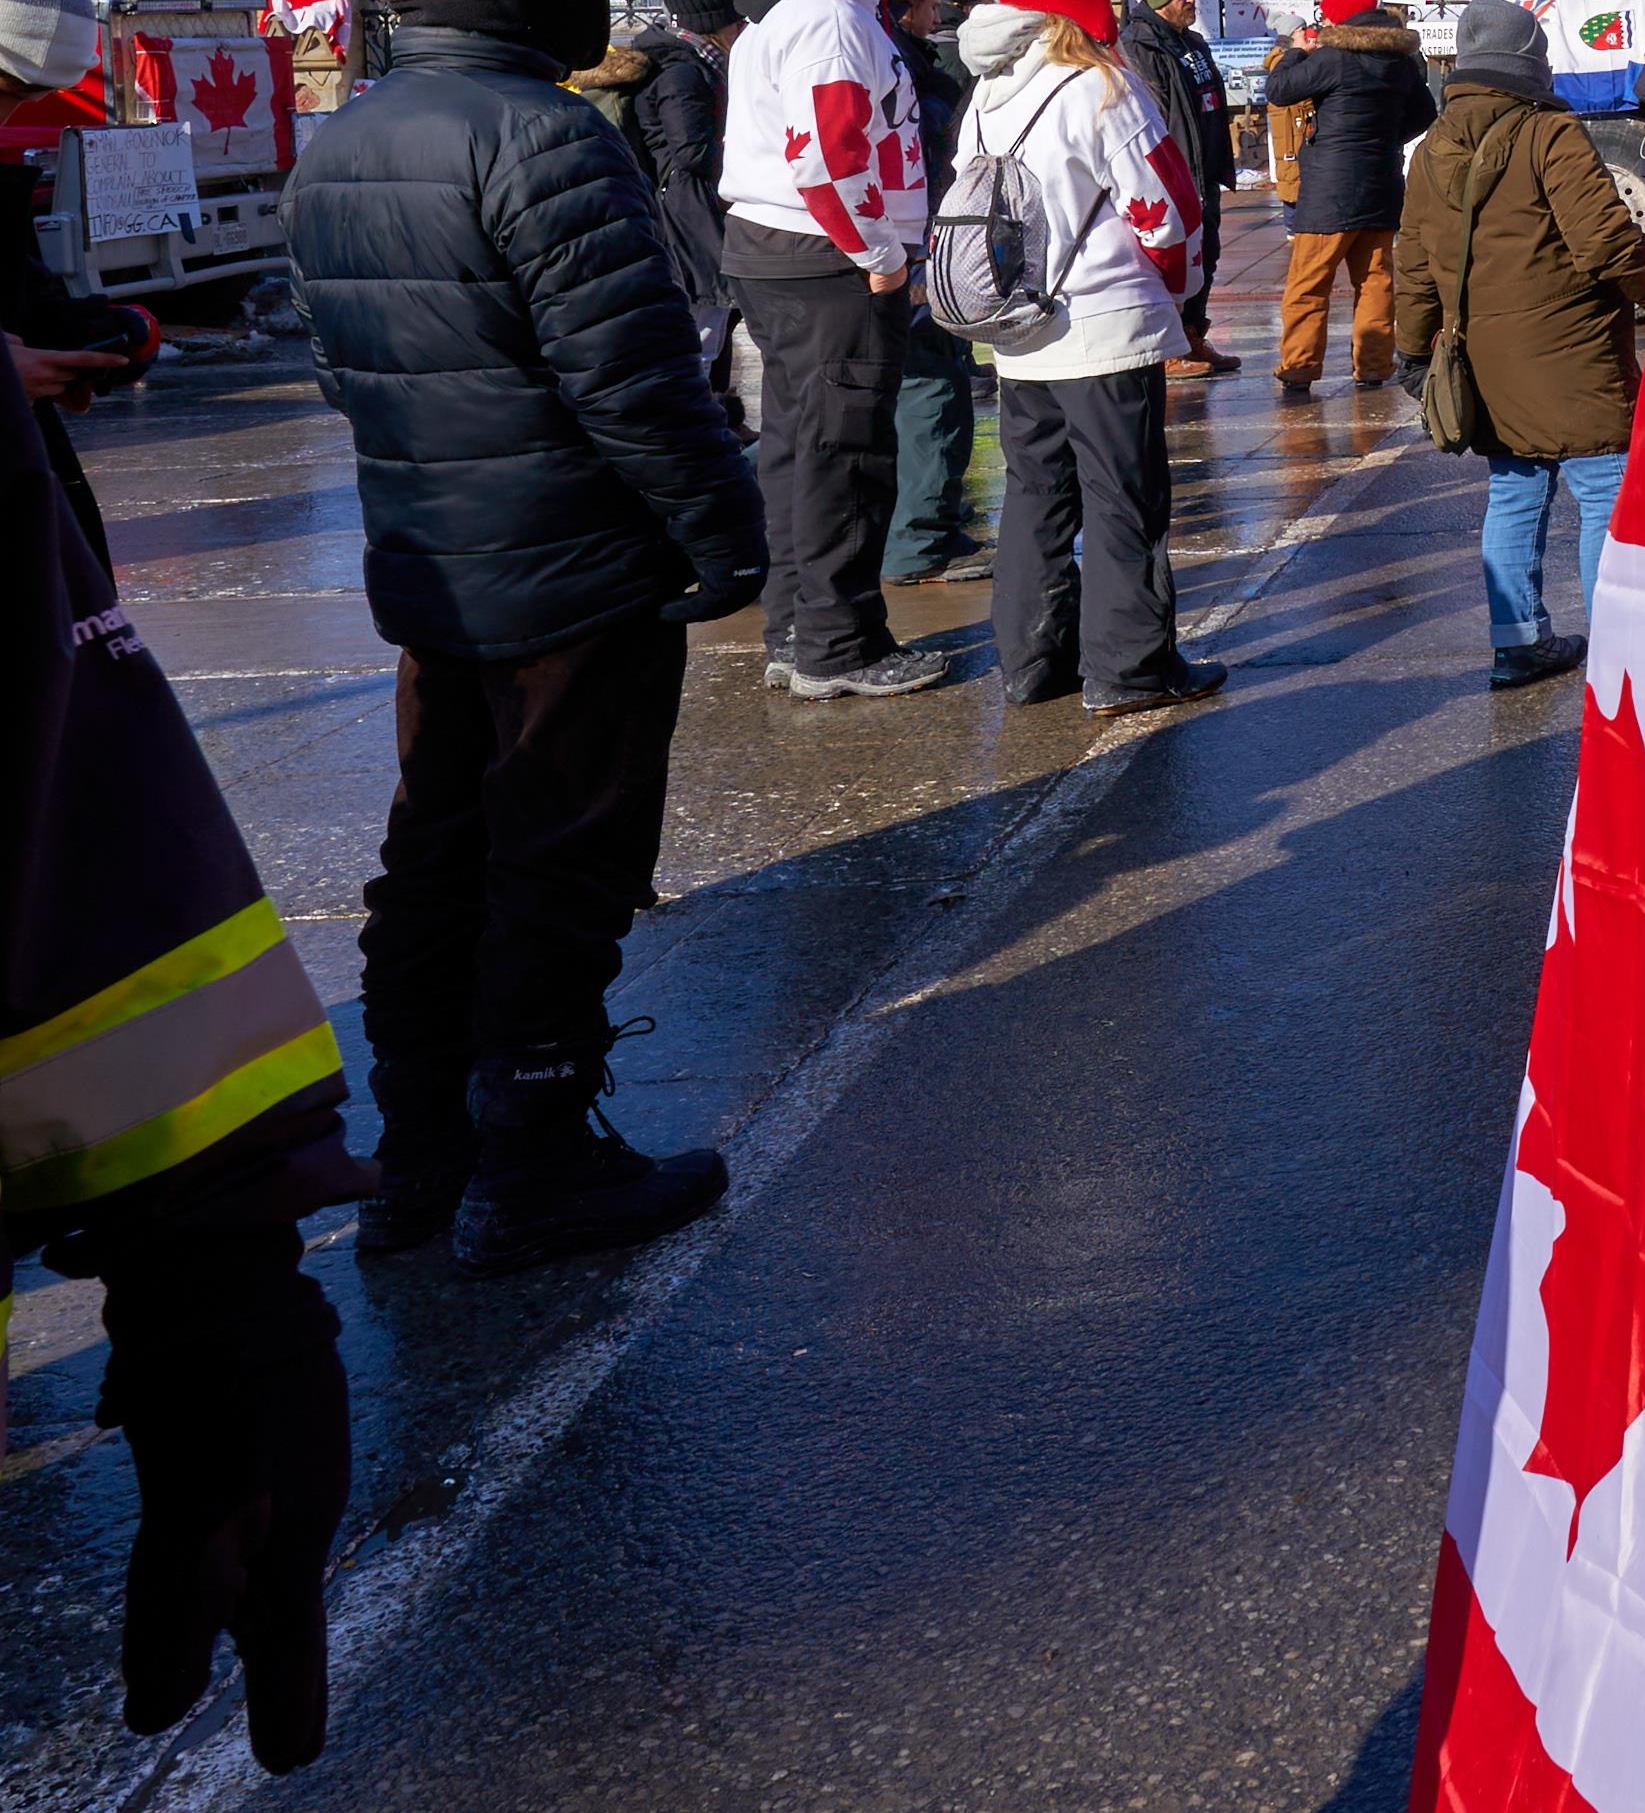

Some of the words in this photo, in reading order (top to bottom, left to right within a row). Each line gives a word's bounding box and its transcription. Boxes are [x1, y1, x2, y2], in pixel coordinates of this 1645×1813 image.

[1422, 27, 1454, 40] TRADES
[139, 152, 157, 169] TO
[143, 169, 186, 186] ABOUT
[513, 1066, 556, 1081] kamik
